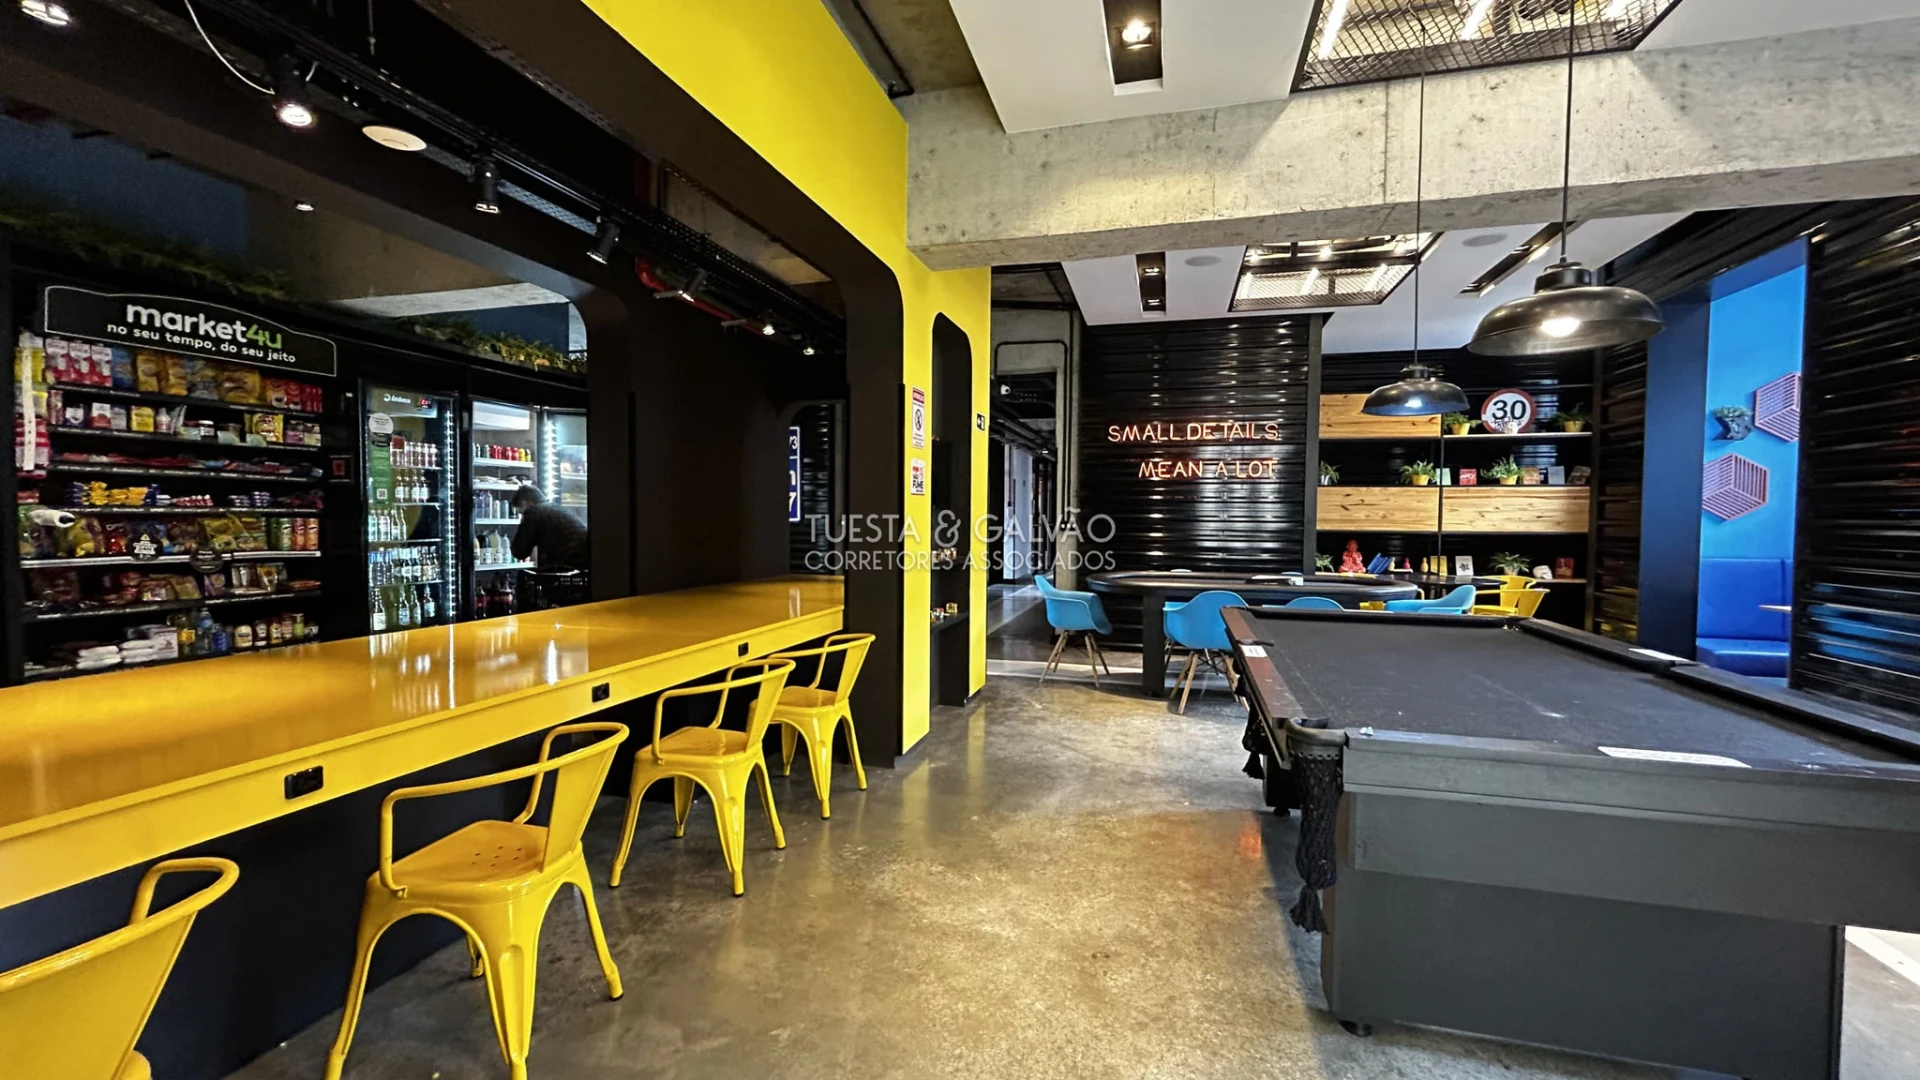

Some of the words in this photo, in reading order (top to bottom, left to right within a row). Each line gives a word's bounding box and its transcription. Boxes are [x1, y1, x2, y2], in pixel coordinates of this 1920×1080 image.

[126, 304, 283, 349] market4u
[106, 323, 128, 335] no
[133, 328, 160, 340] seu
[165, 333, 216, 351] tempo,
[220, 342, 238, 353] do
[241, 346, 264, 358] seu
[266, 350, 296, 363] jeito
[1492, 400, 1526, 420] 30
[1107, 424, 1186, 442] SMALL
[1187, 422, 1279, 440] DETAILS
[1138, 461, 1203, 478] MEAN
[1215, 461, 1228, 477] A
[1236, 460, 1278, 478] LOT
